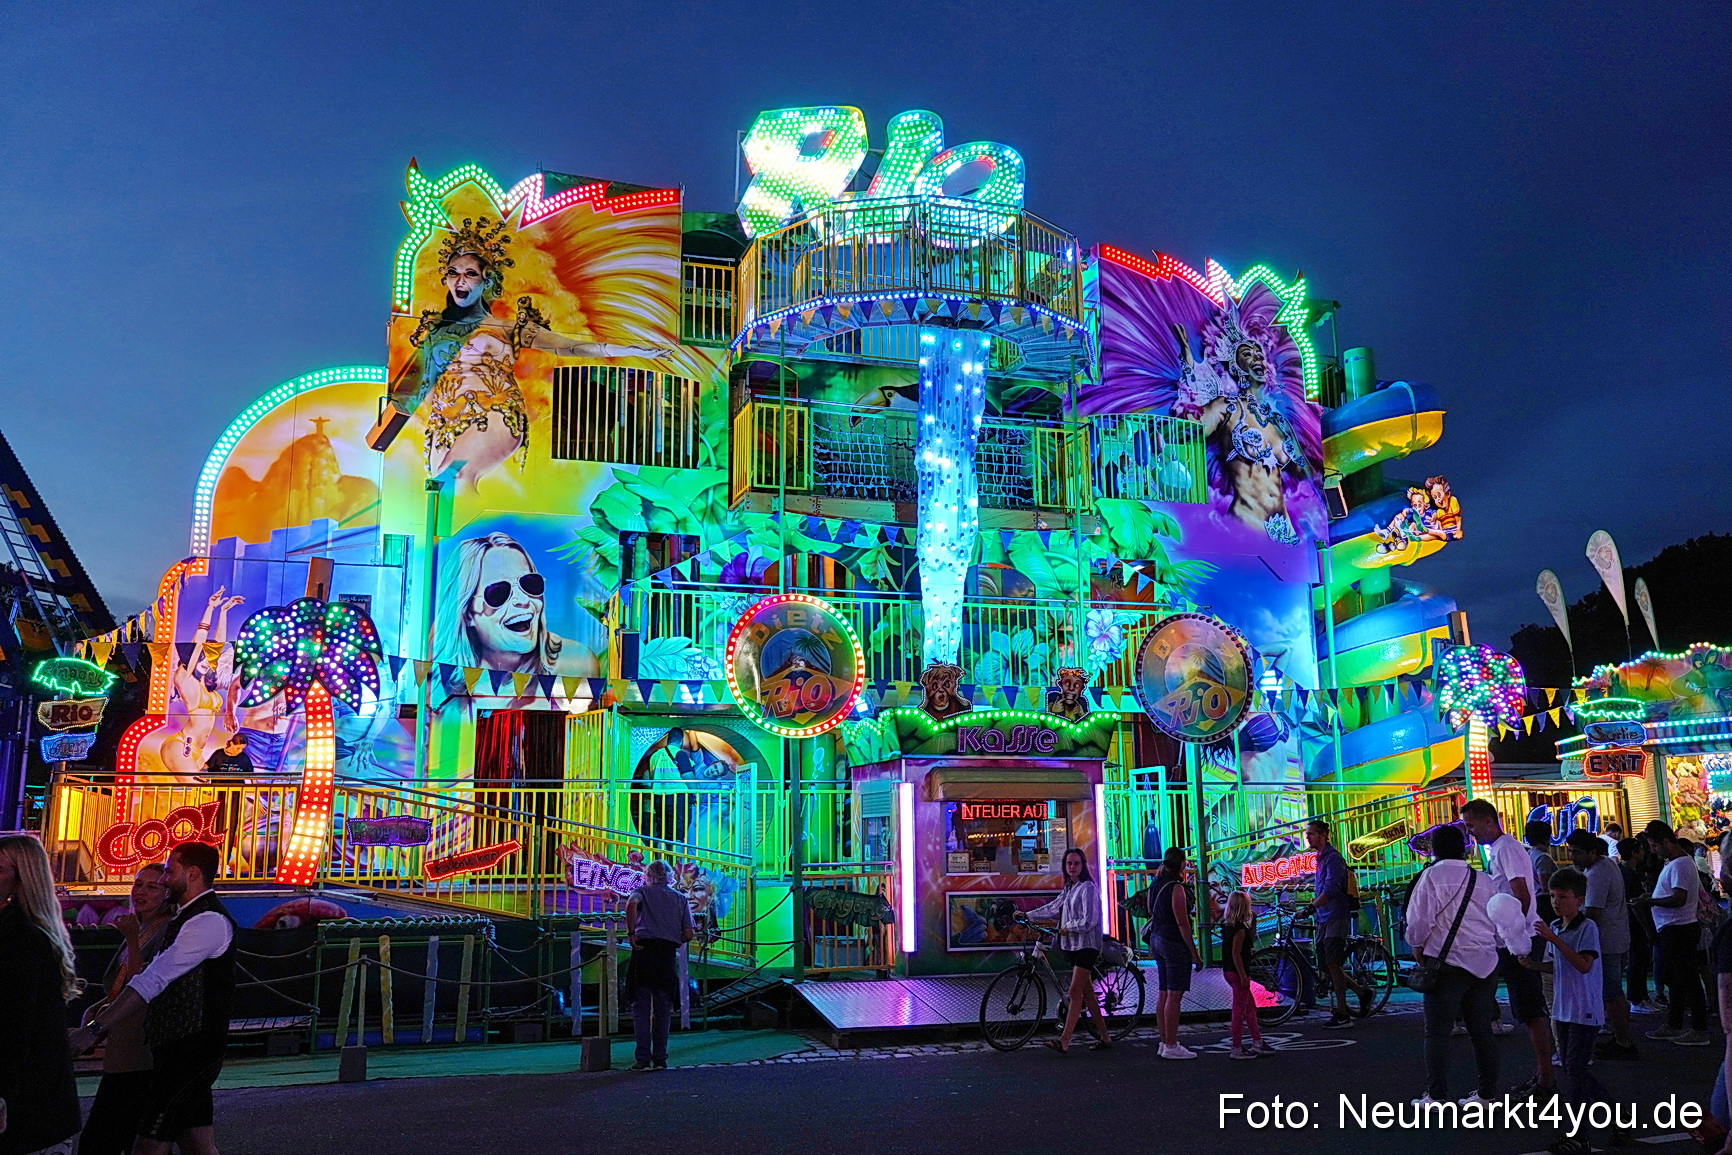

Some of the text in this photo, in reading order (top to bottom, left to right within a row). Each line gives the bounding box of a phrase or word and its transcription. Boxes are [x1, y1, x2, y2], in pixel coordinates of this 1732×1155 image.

[735, 105, 1026, 250] Rio
[957, 725, 1059, 753] Kasse
[1588, 724, 1643, 742] Sortie
[96, 800, 229, 867] COOL
[813, 889, 886, 921] Eingang
